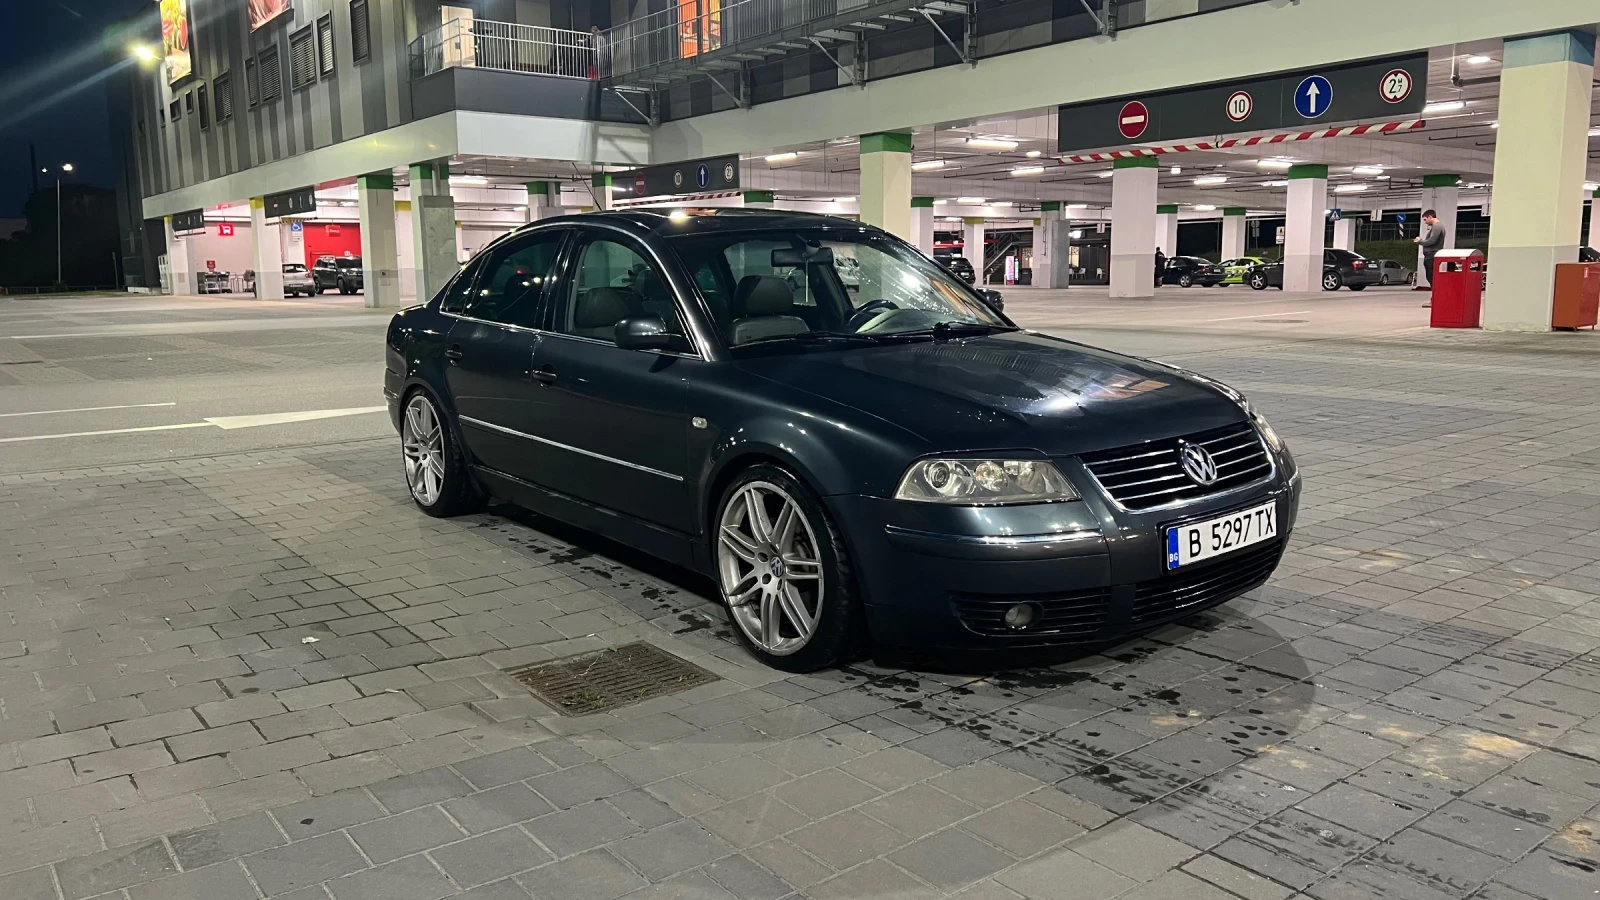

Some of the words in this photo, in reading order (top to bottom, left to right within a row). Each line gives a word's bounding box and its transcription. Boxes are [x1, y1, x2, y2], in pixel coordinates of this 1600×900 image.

[1234, 99, 1246, 114] 10
[1189, 528, 1202, 558] B
[1212, 513, 1252, 551] 5297
[1255, 506, 1273, 537] TX
[1169, 553, 1179, 563] BG
